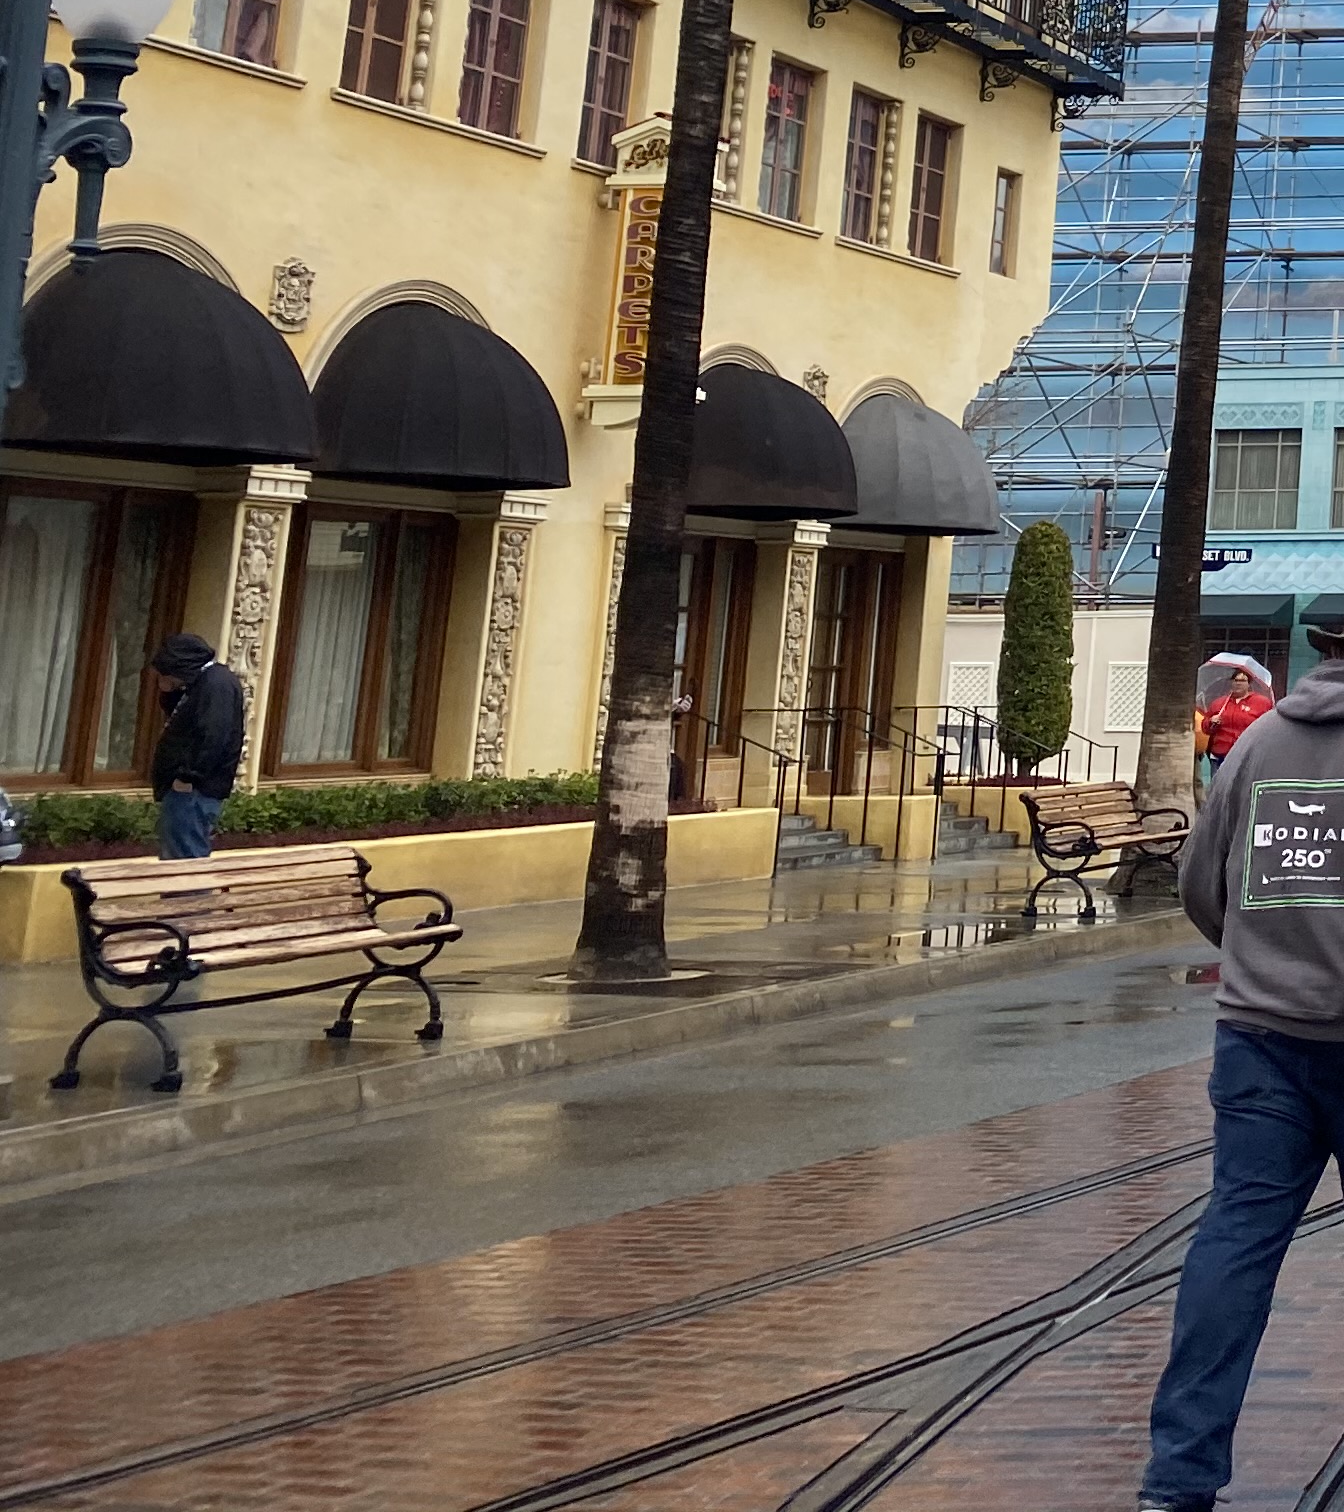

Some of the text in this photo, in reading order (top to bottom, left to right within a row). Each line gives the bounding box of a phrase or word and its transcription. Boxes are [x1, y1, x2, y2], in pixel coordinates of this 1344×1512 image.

[614, 195, 663, 377] CARPETS
[1223, 551, 1250, 562] BLVD.
[1281, 848, 1325, 868] 250
